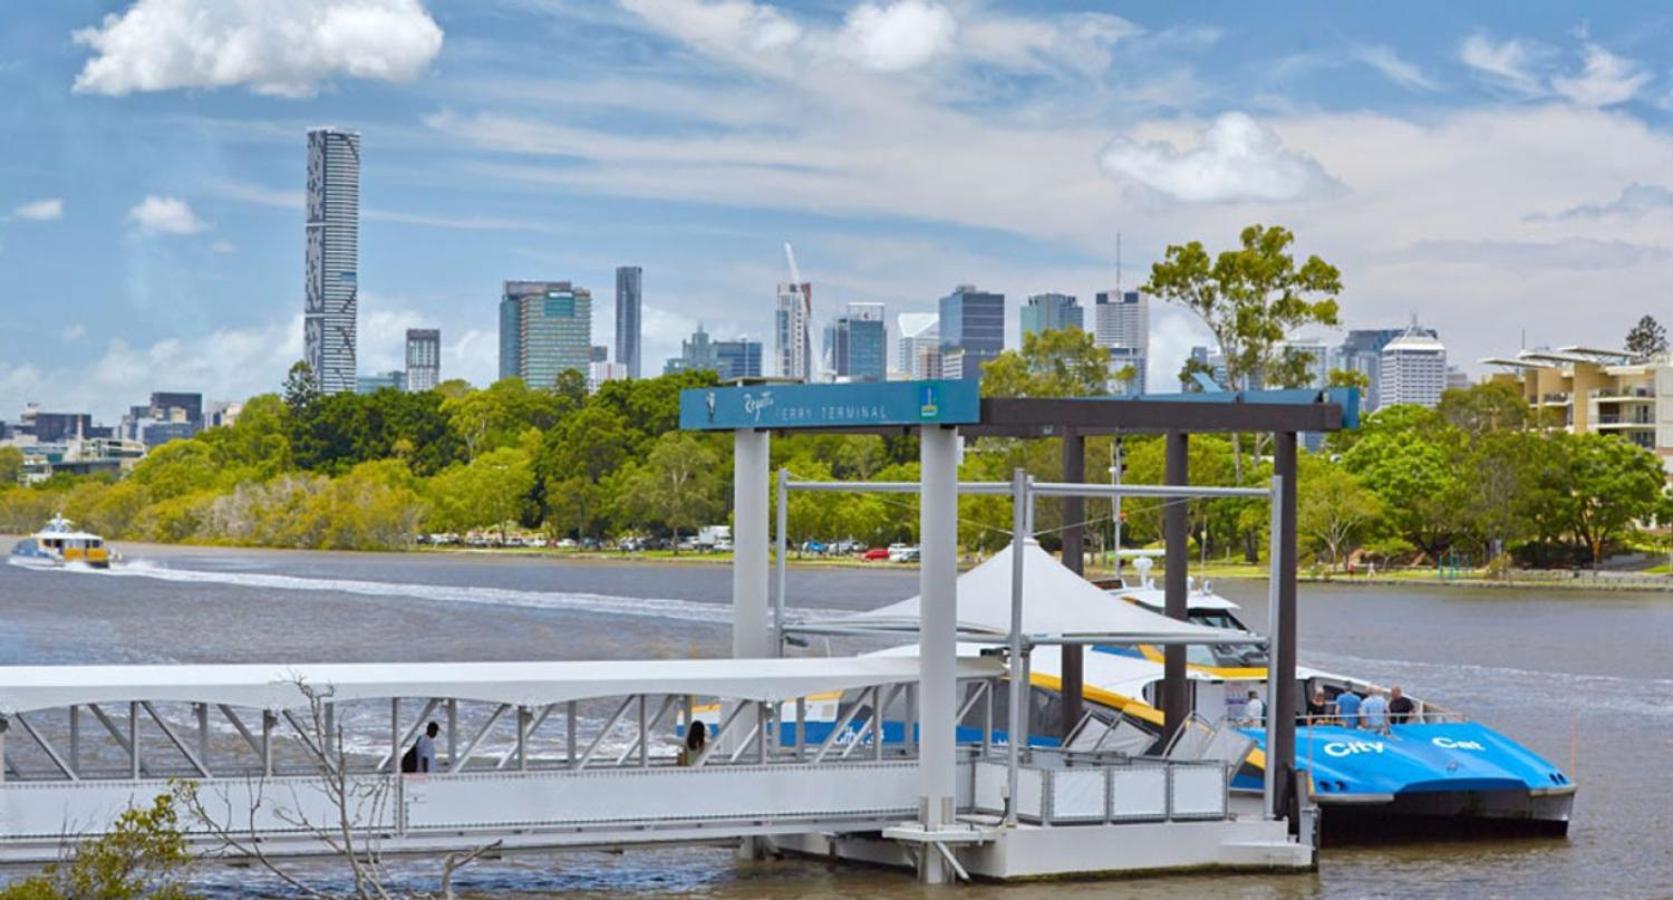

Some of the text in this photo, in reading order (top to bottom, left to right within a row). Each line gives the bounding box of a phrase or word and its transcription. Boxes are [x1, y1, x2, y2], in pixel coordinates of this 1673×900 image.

[775, 405, 888, 420] ERRY TERMINAL
[1323, 736, 1487, 758] City Cat
